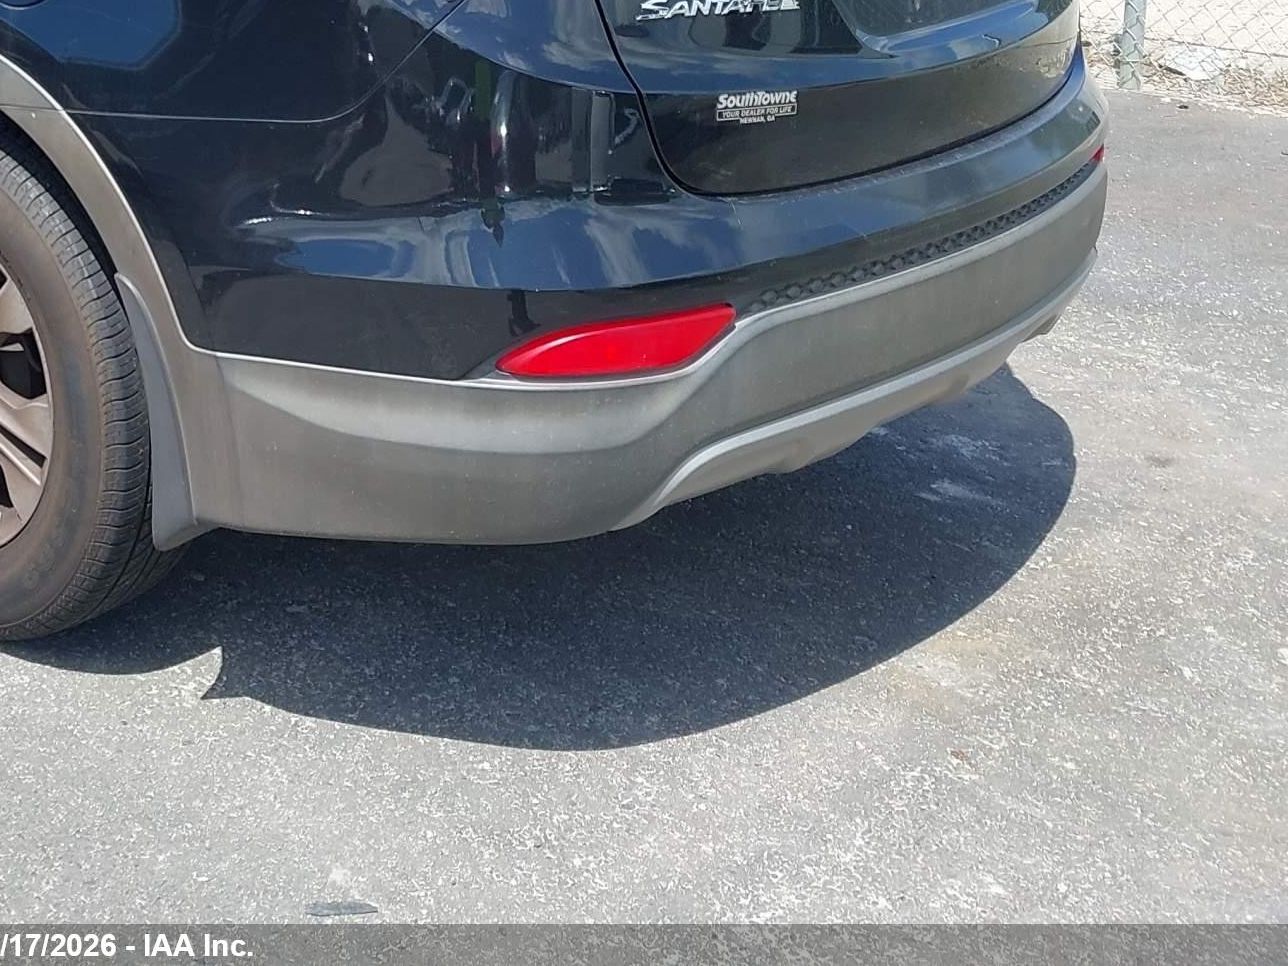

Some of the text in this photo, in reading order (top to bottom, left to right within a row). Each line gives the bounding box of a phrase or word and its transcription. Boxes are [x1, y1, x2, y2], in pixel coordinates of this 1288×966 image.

[716, 90, 798, 109] SouthTowne
[722, 106, 792, 119] YOUR DEALER FOR LIFE
